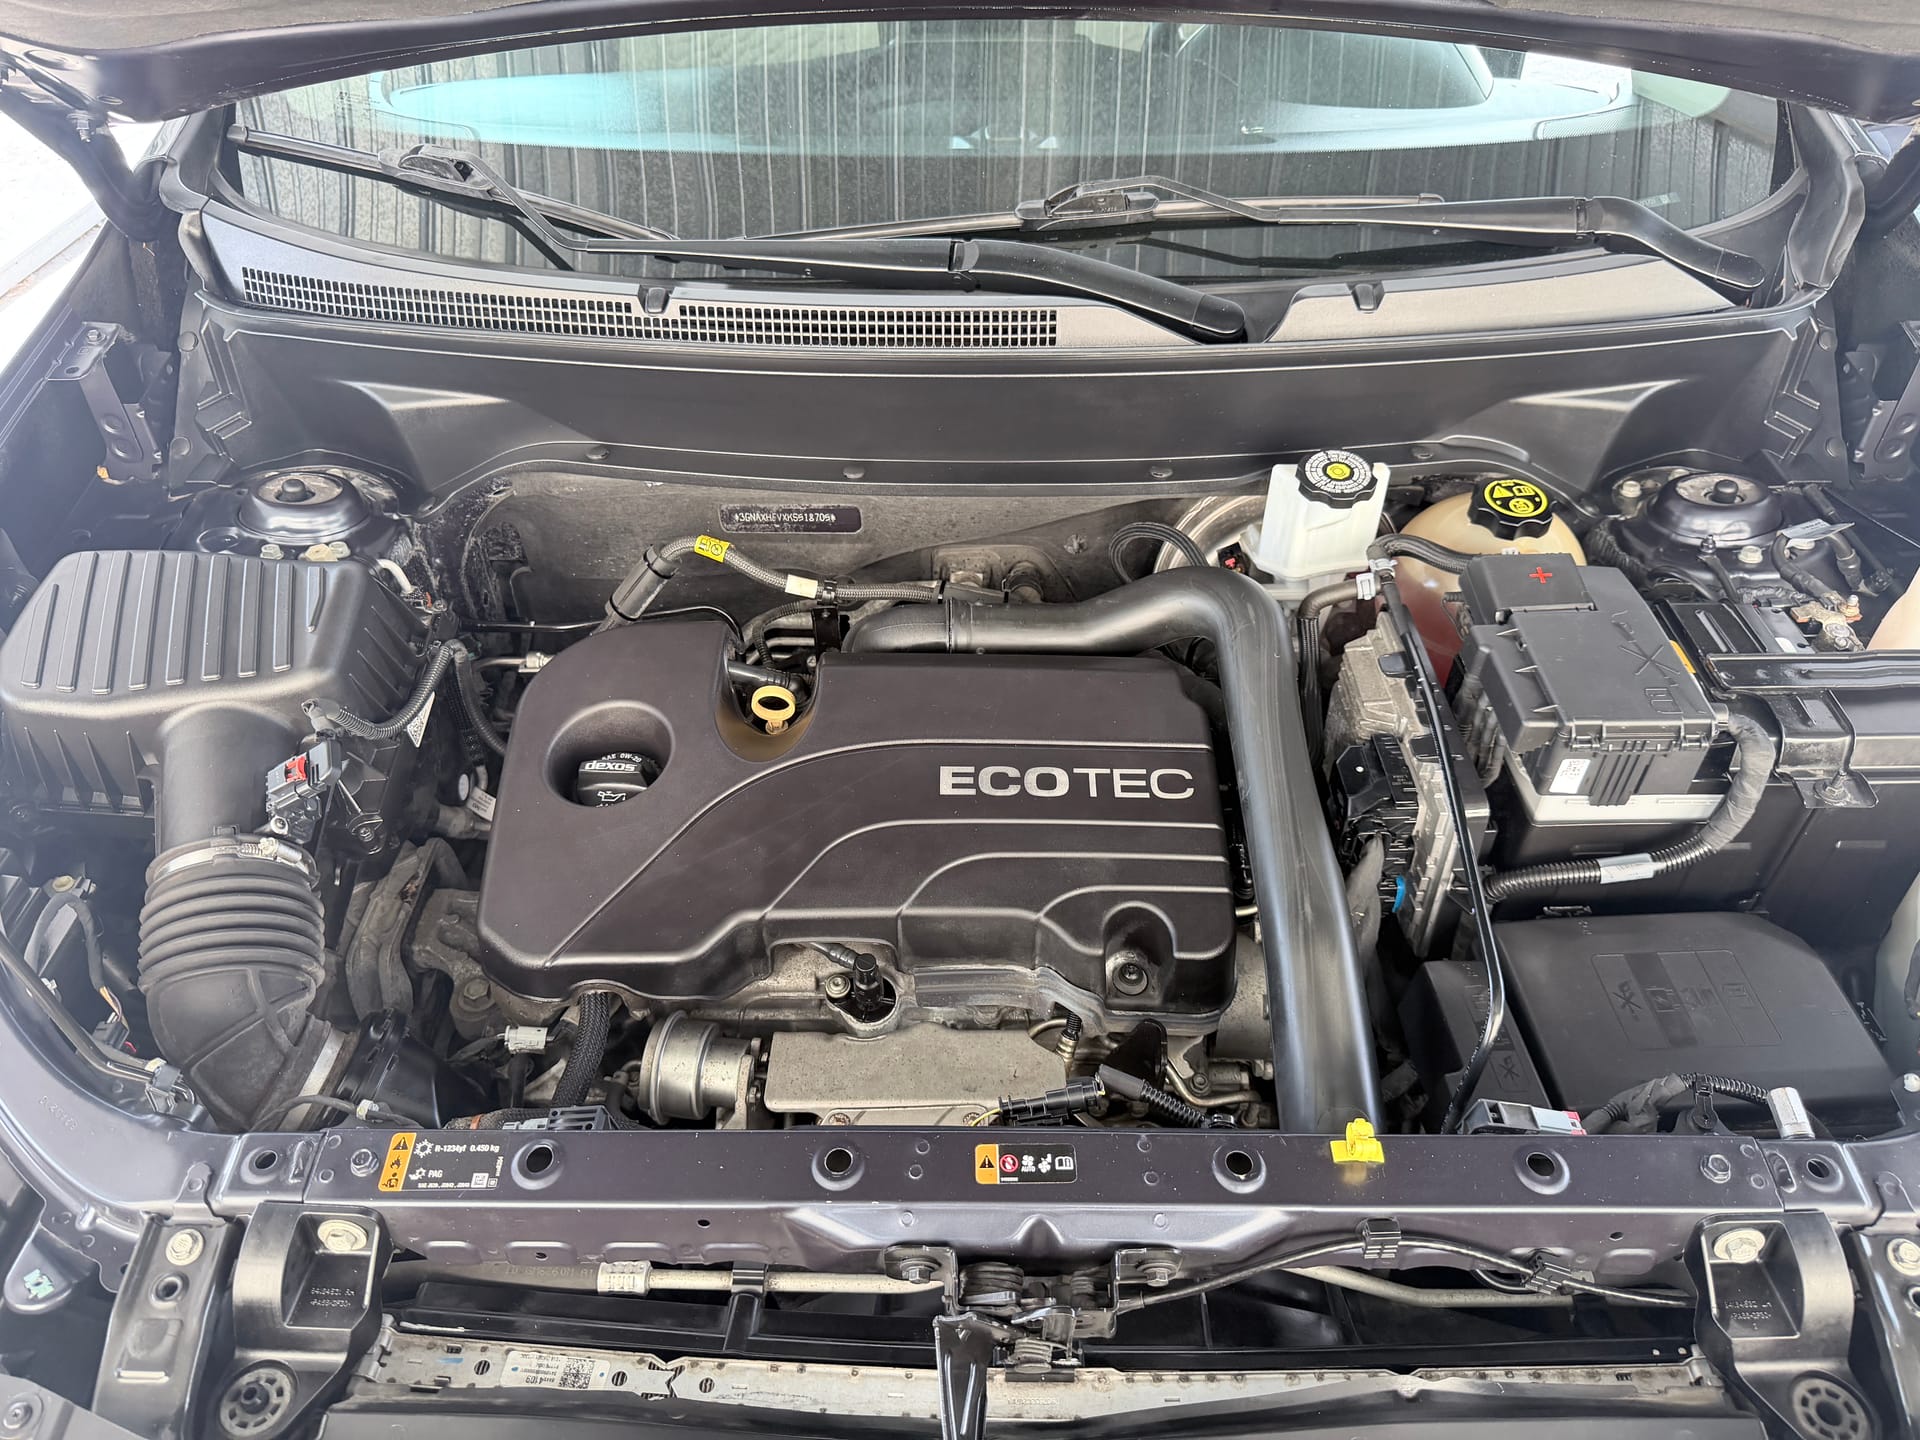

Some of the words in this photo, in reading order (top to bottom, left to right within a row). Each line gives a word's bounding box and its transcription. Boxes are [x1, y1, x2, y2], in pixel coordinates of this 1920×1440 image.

[584, 760, 638, 772] dexos
[939, 765, 1195, 800] ECOTEC
[434, 1144, 467, 1155] R-1234yf
[469, 1144, 489, 1153] 0.450
[490, 1144, 500, 1154] kg
[427, 1169, 443, 1178] PAG
[1020, 1165, 1036, 1173] AUTO
